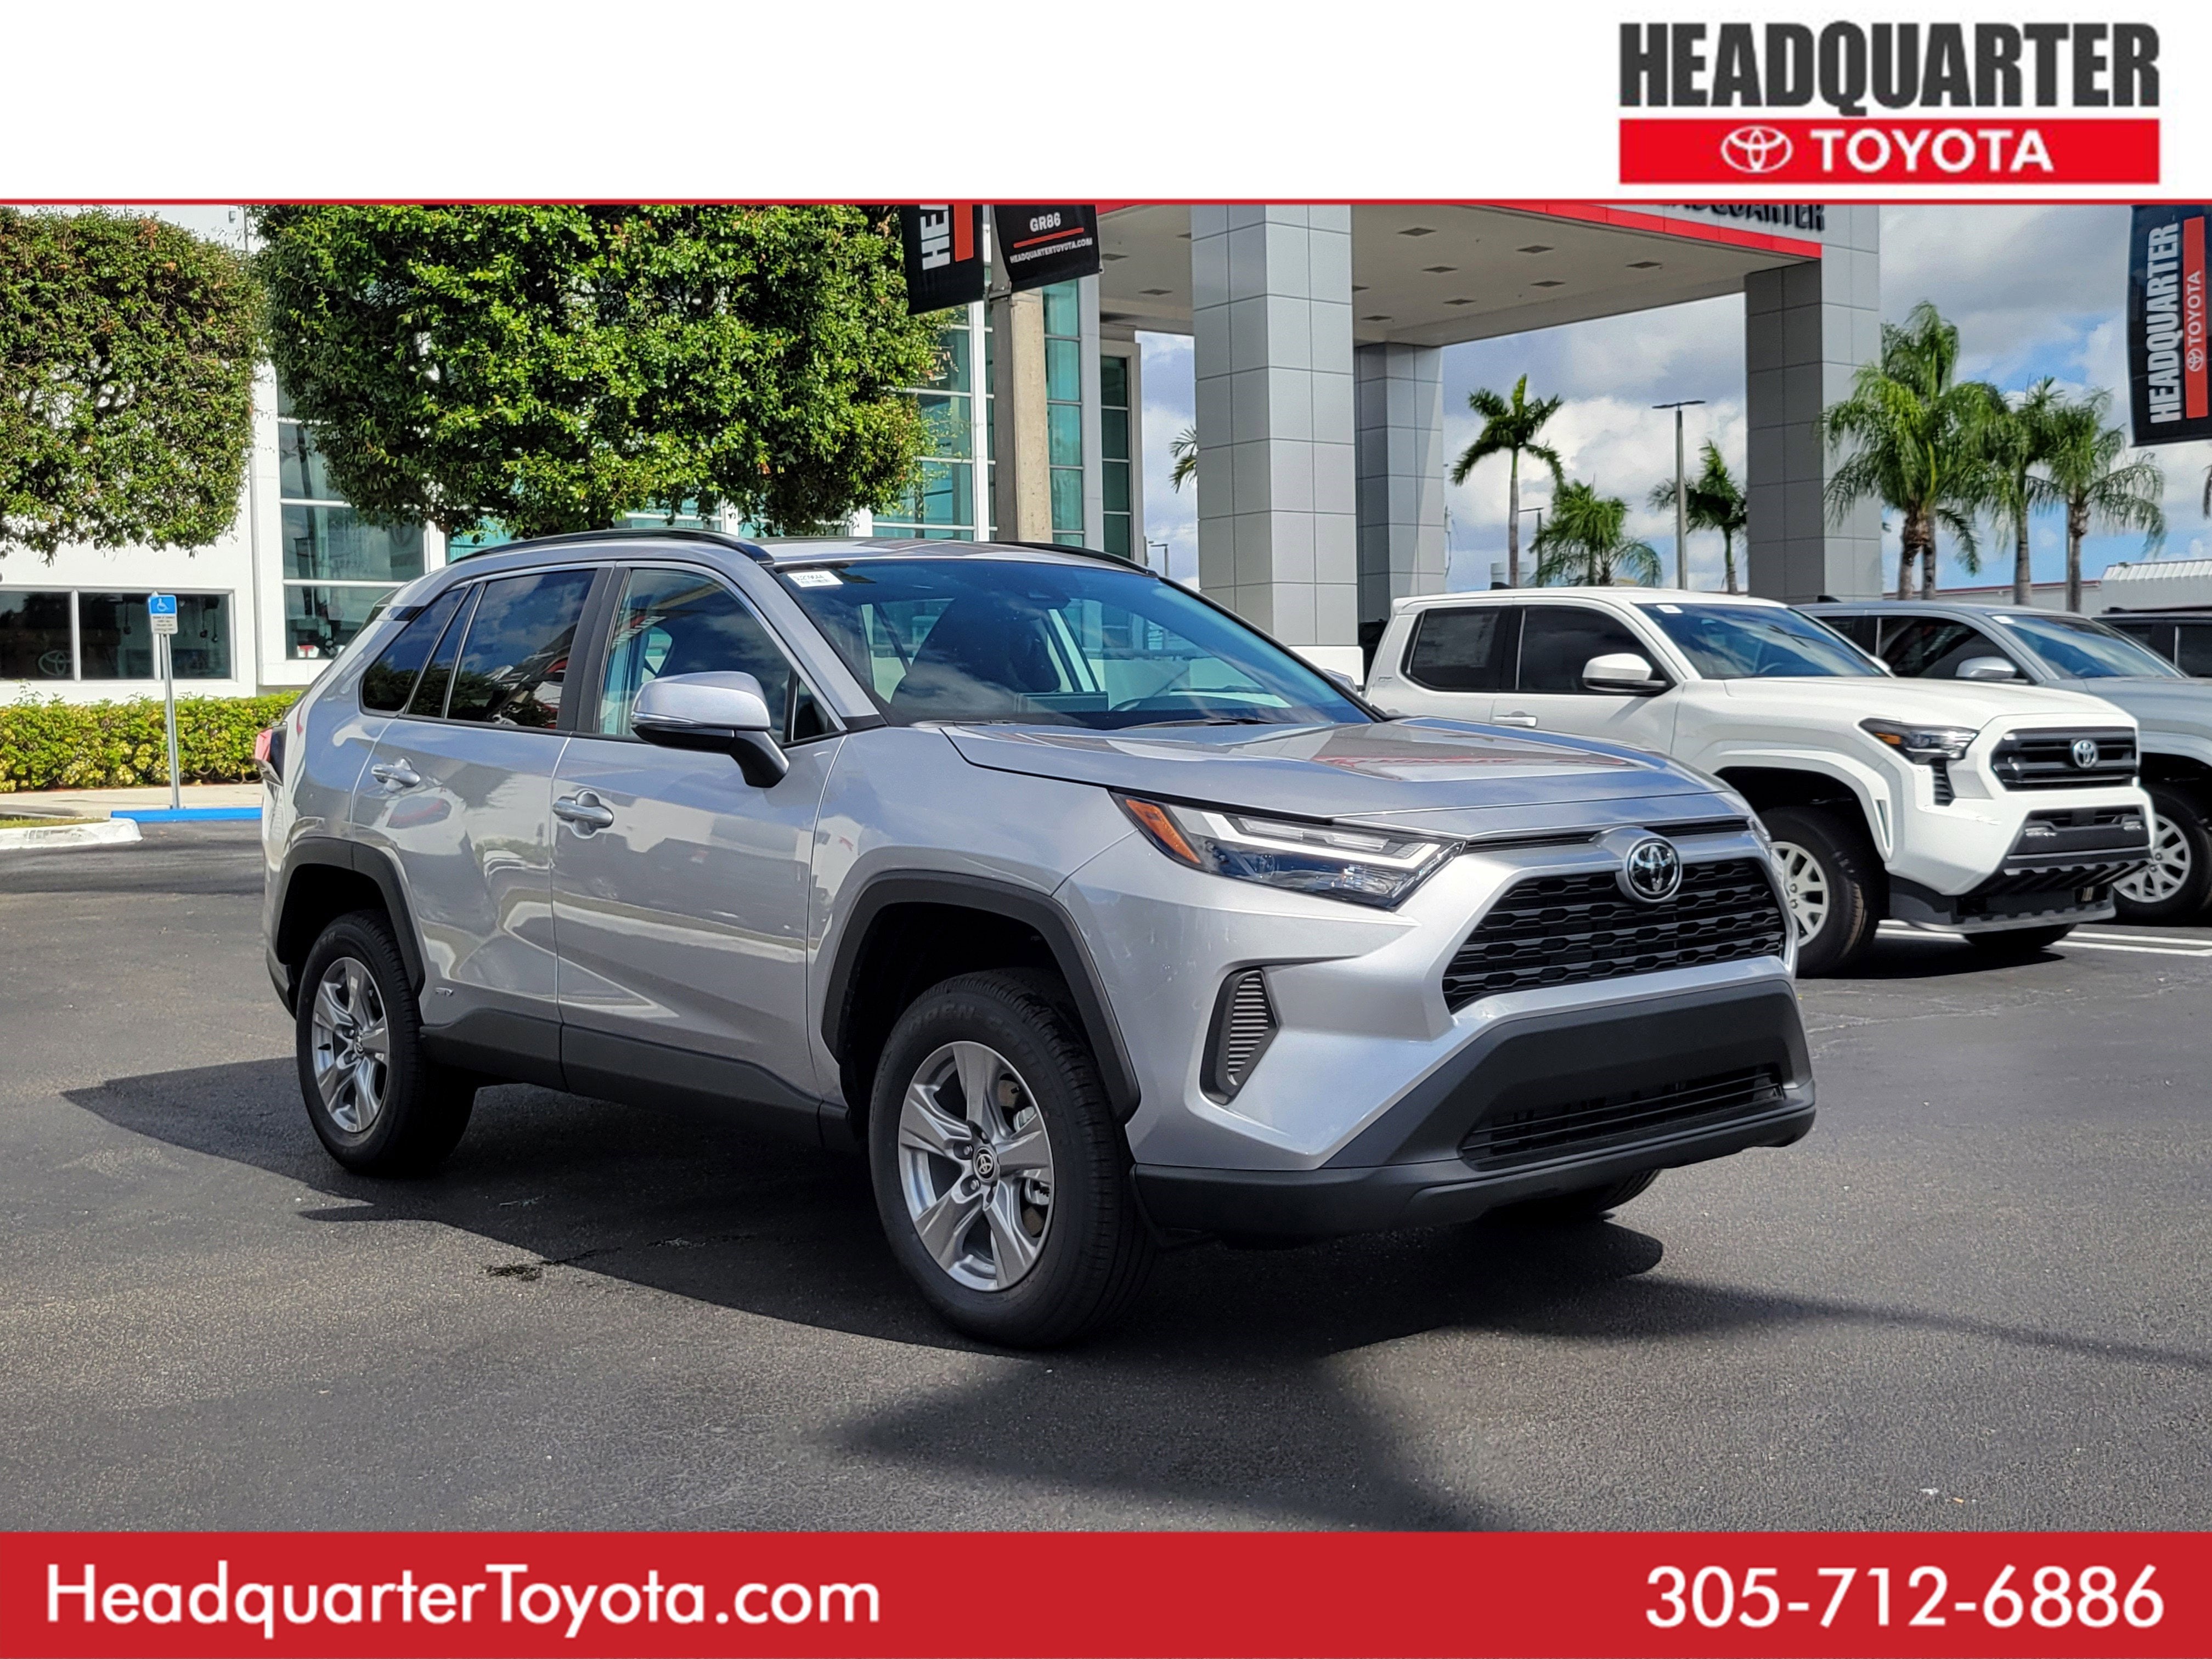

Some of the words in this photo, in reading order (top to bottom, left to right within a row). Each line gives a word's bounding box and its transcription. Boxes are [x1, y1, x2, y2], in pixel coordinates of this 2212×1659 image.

[919, 204, 950, 270] HE
[1009, 237, 1093, 263] HEADQUARTERTOYOTA.COM
[1029, 212, 1062, 232] GR86
[2146, 222, 2183, 424] HEADQUARTER
[2187, 270, 2202, 347] TOYOTA
